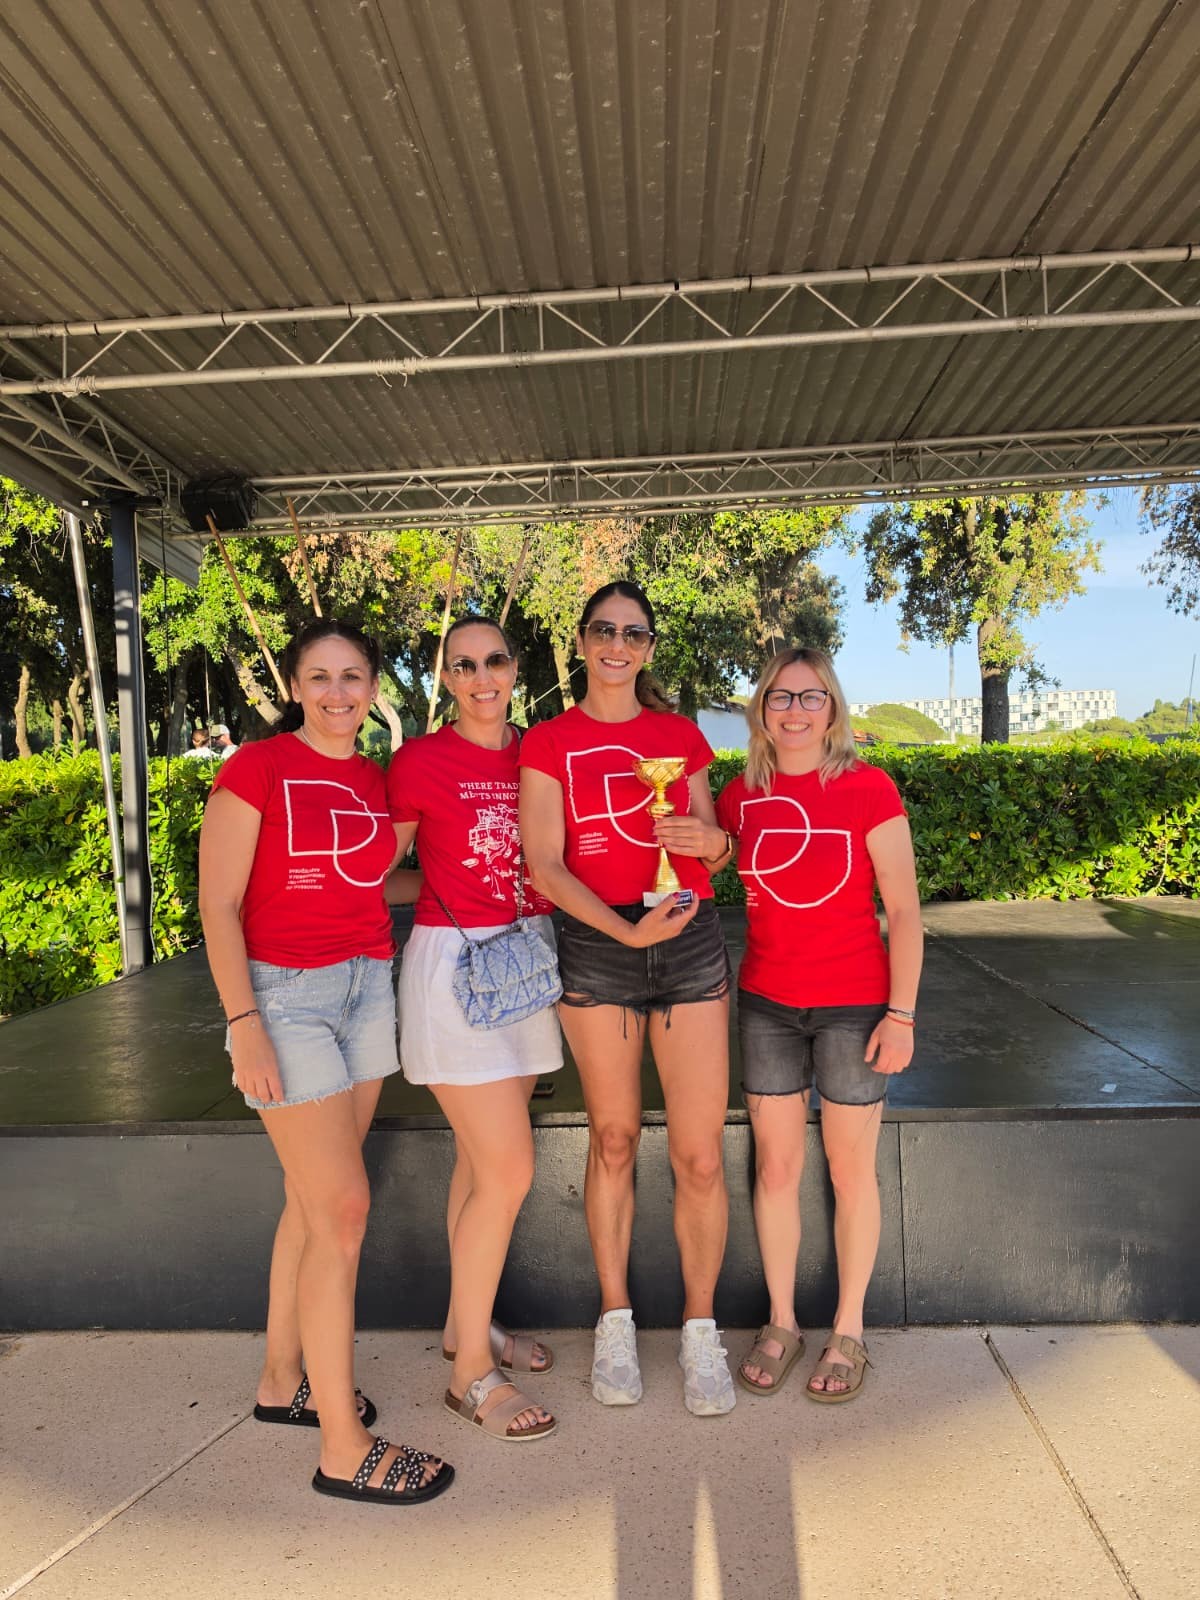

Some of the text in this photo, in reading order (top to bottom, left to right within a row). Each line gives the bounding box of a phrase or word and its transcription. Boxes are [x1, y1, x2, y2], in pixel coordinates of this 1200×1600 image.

[458, 781, 520, 790] WHERE TRAD
[459, 791, 491, 800] METS
